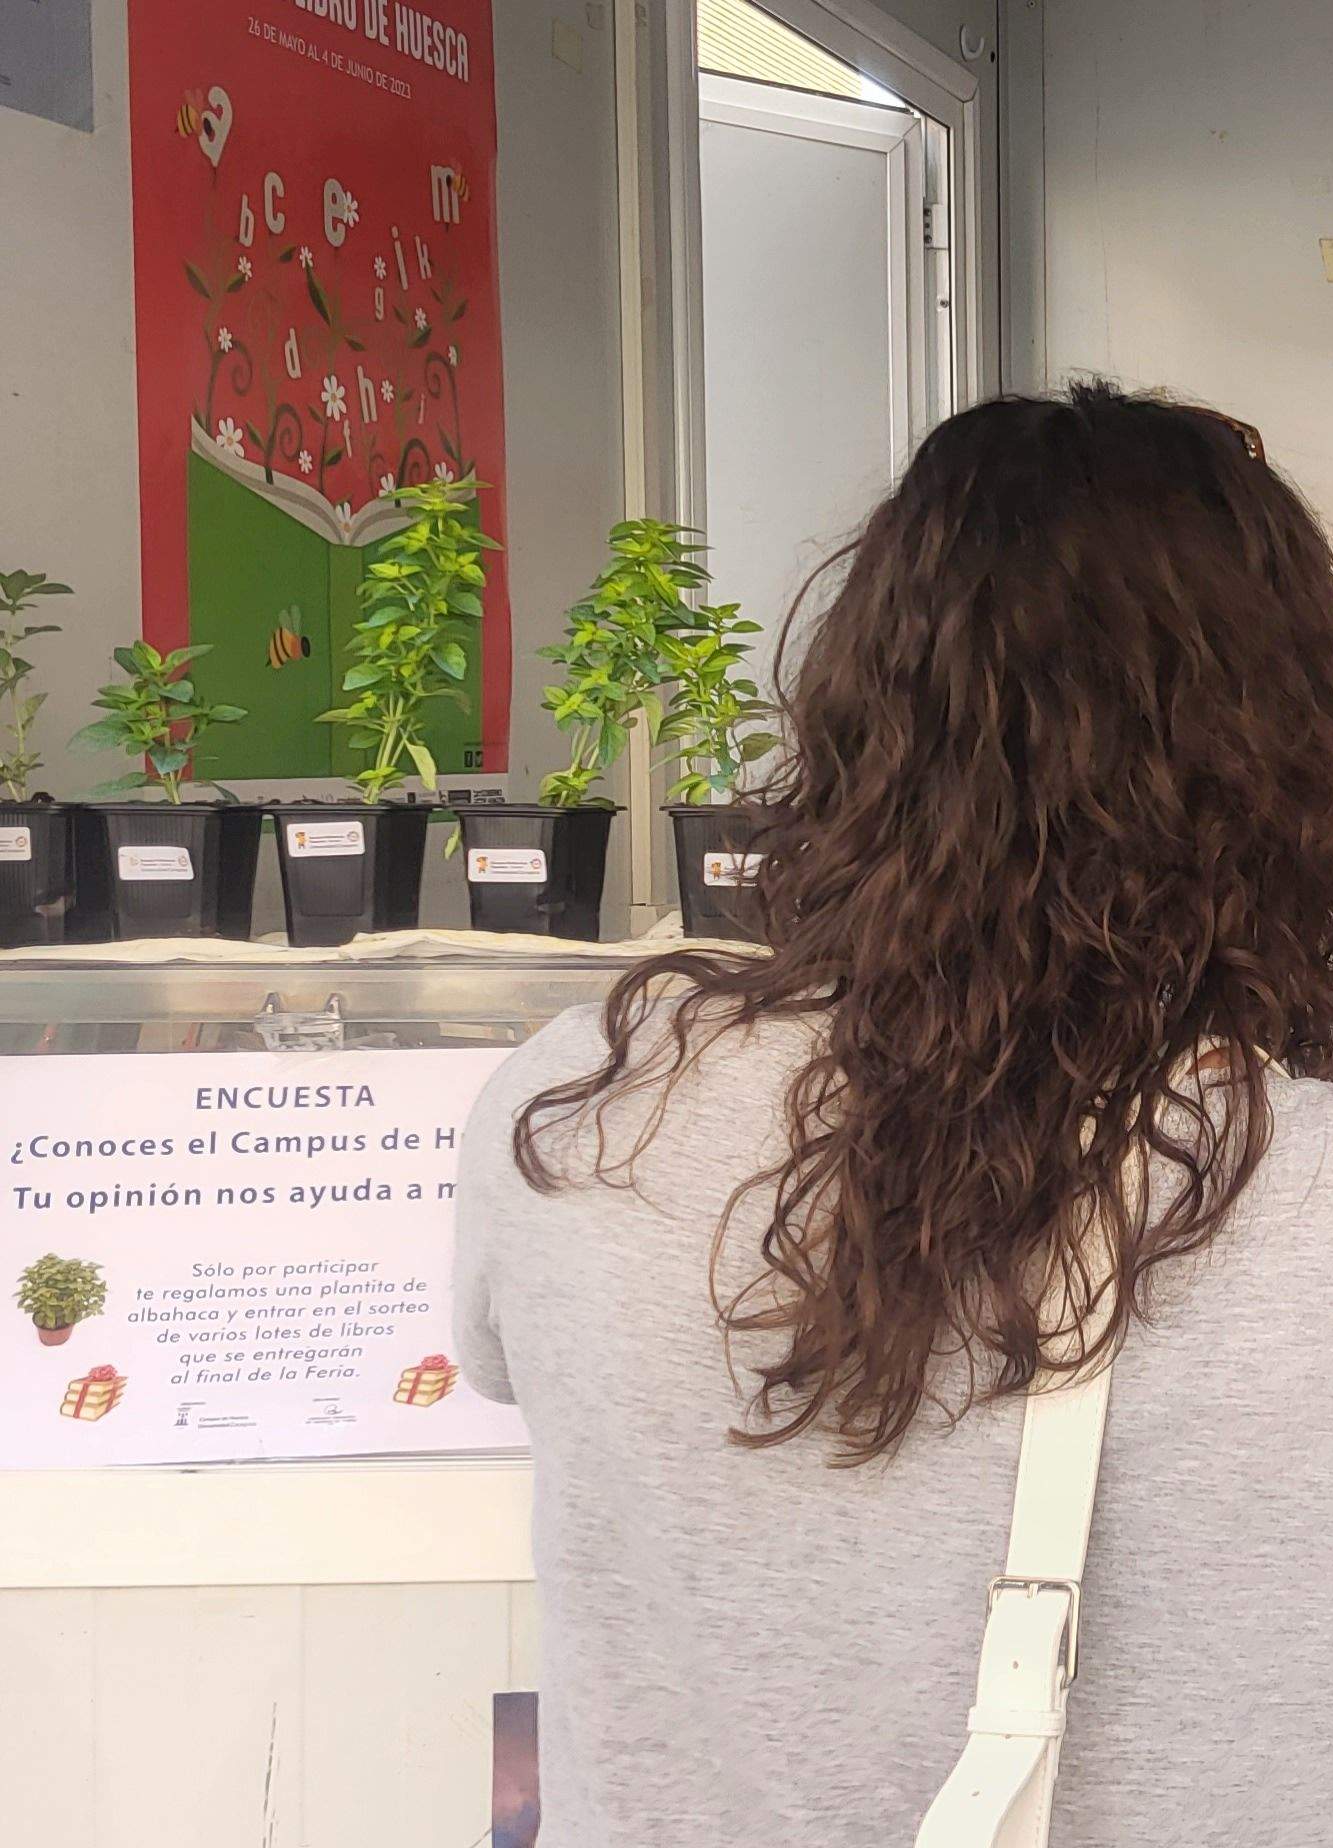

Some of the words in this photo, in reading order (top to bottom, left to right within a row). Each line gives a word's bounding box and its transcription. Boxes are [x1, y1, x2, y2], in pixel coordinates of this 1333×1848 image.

[395, 2, 469, 82] HUESCA
[249, 17, 260, 36] 26
[264, 24, 277, 43] DE
[280, 31, 305, 55] MAYO
[308, 45, 320, 61] AL
[322, 52, 329, 65] 4
[331, 55, 343, 72] DE
[346, 61, 373, 84] JUNIO
[376, 72, 388, 88] DE
[390, 77, 411, 99] 2023
[196, 1085, 376, 1110] ENCUESTA
[10, 1134, 174, 1165] ¿Conoces
[187, 1131, 217, 1155] el
[230, 1131, 367, 1158] Campus
[380, 1127, 421, 1151] de
[12, 1186, 52, 1210] Tu
[66, 1183, 202, 1214] opinión
[217, 1184, 276, 1206] nos
[289, 1177, 393, 1209] ayuda
[406, 1184, 423, 1201] a
[192, 1262, 235, 1278] Sólo
[242, 1264, 277, 1280] por
[283, 1260, 380, 1278] participar
[136, 1287, 154, 1301] te
[162, 1283, 268, 1303] regalamos
[275, 1284, 312, 1297] una
[320, 1279, 395, 1299] plantita
[403, 1277, 427, 1292] de
[127, 1307, 219, 1324] albahaca
[227, 1308, 238, 1323] y
[244, 1304, 307, 1320] entrar
[312, 1304, 336, 1317] en
[344, 1300, 362, 1316] el
[368, 1300, 429, 1315] sorteo
[156, 1329, 181, 1344] de
[188, 1326, 247, 1342] varios
[255, 1325, 301, 1340] lotes
[309, 1323, 333, 1339] de
[340, 1321, 395, 1337] libros
[179, 1350, 217, 1367] que
[224, 1350, 245, 1362] se
[252, 1345, 363, 1362] entregarán
[171, 1369, 188, 1385] al
[197, 1368, 240, 1384] final
[247, 1367, 272, 1382] de
[279, 1366, 298, 1381] la
[305, 1364, 361, 1380] Feria.
